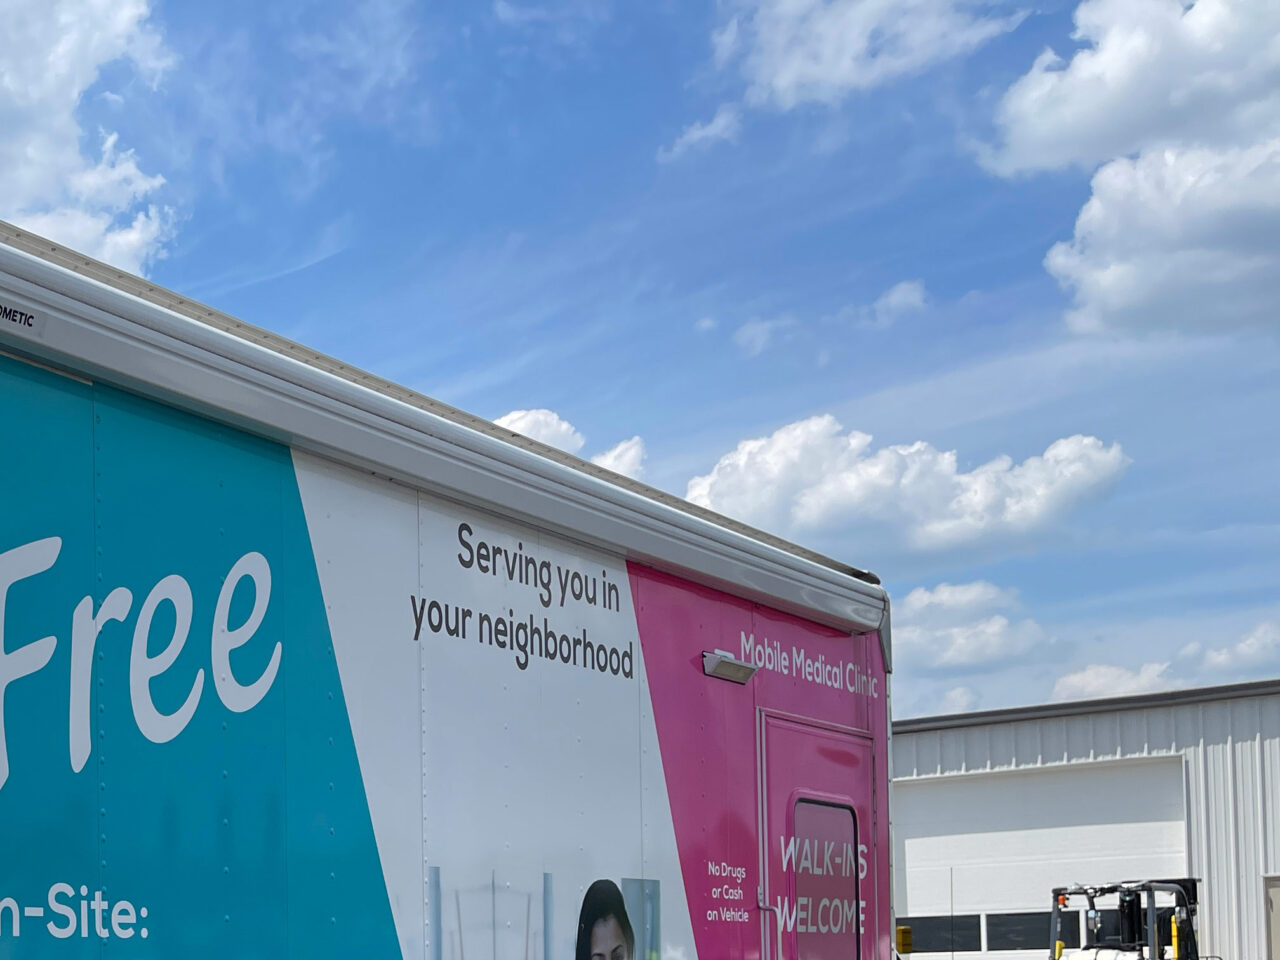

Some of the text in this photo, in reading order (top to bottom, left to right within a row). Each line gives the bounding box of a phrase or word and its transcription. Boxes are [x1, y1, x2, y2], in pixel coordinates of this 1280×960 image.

[458, 523, 620, 612] Serving you in
[410, 595, 634, 679] your neighborhood
[741, 631, 879, 699] Mobile Medical Clinic
[708, 861, 746, 884] No Drugs
[780, 836, 868, 880] WALK-INS
[712, 884, 743, 900] or Cash
[707, 907, 749, 923] on Vehicle
[777, 895, 866, 935] WELCOME
